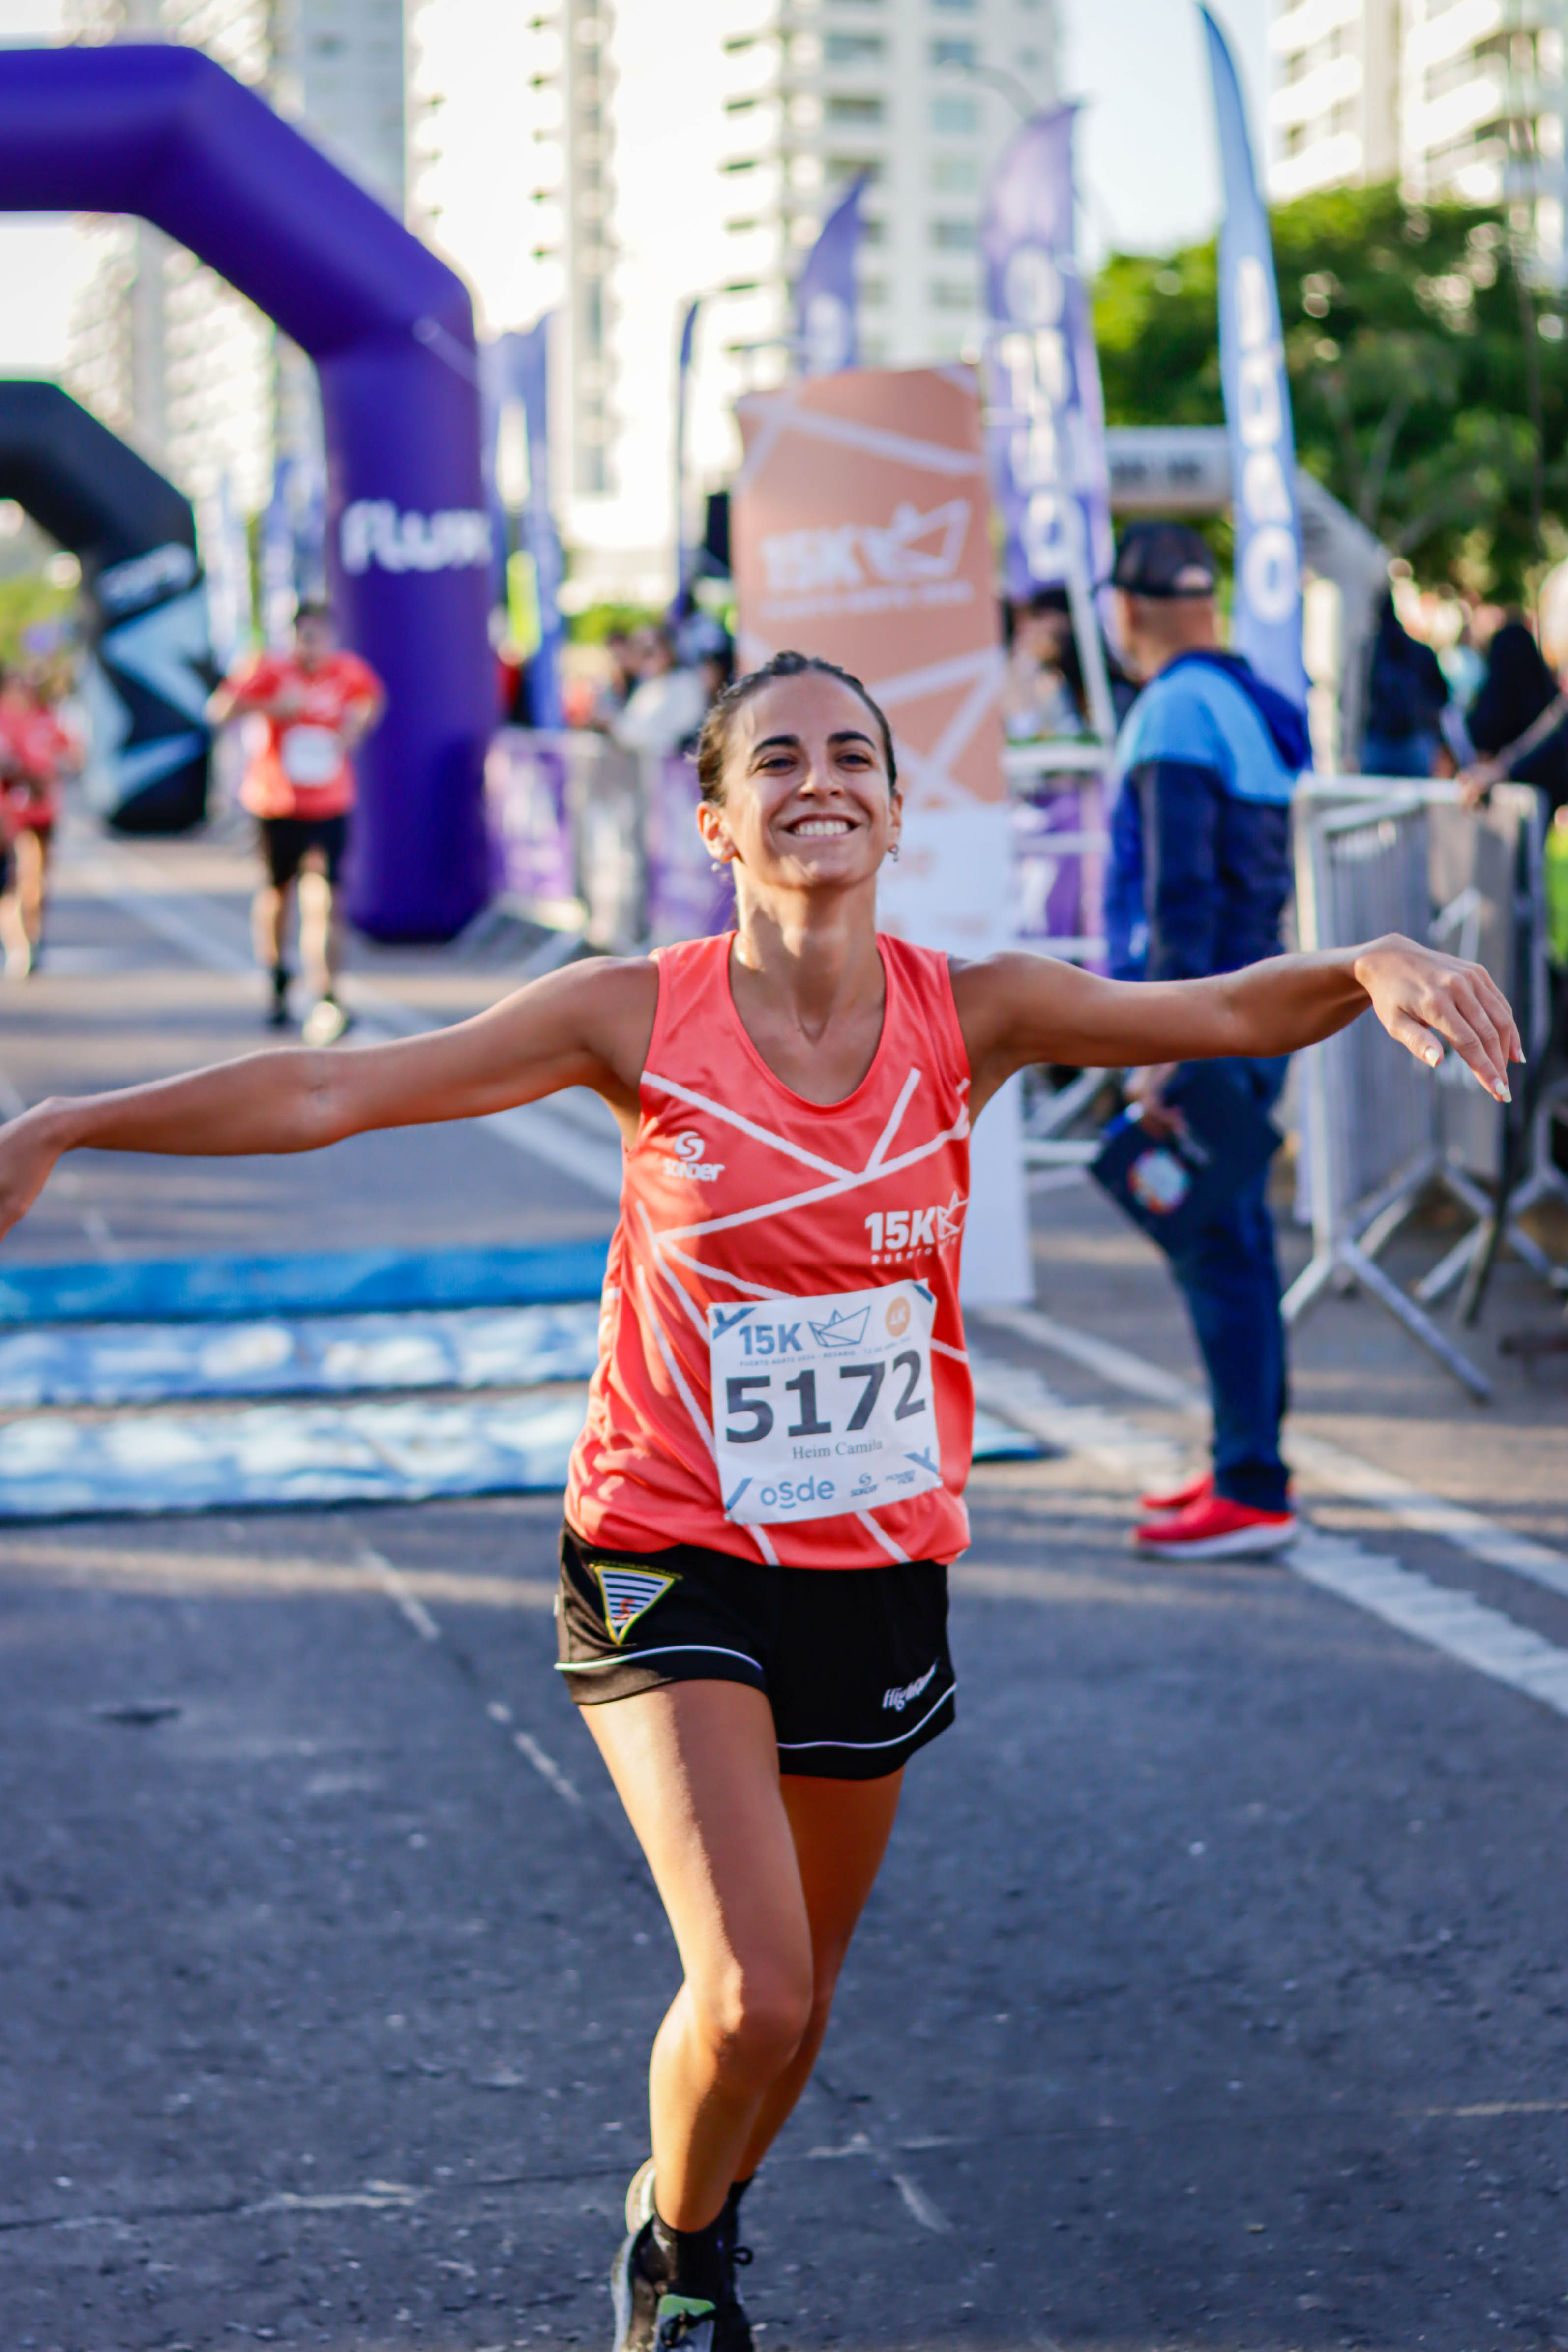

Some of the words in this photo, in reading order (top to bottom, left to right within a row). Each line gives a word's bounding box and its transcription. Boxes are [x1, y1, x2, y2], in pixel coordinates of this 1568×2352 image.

[865, 1206, 936, 1251] 15K
[739, 1322, 803, 1355] 15K
[726, 1349, 926, 1444] 5172
[792, 1443, 831, 1460] Heim
[836, 1439, 883, 1457] Camila
[760, 1476, 834, 1506] osde
